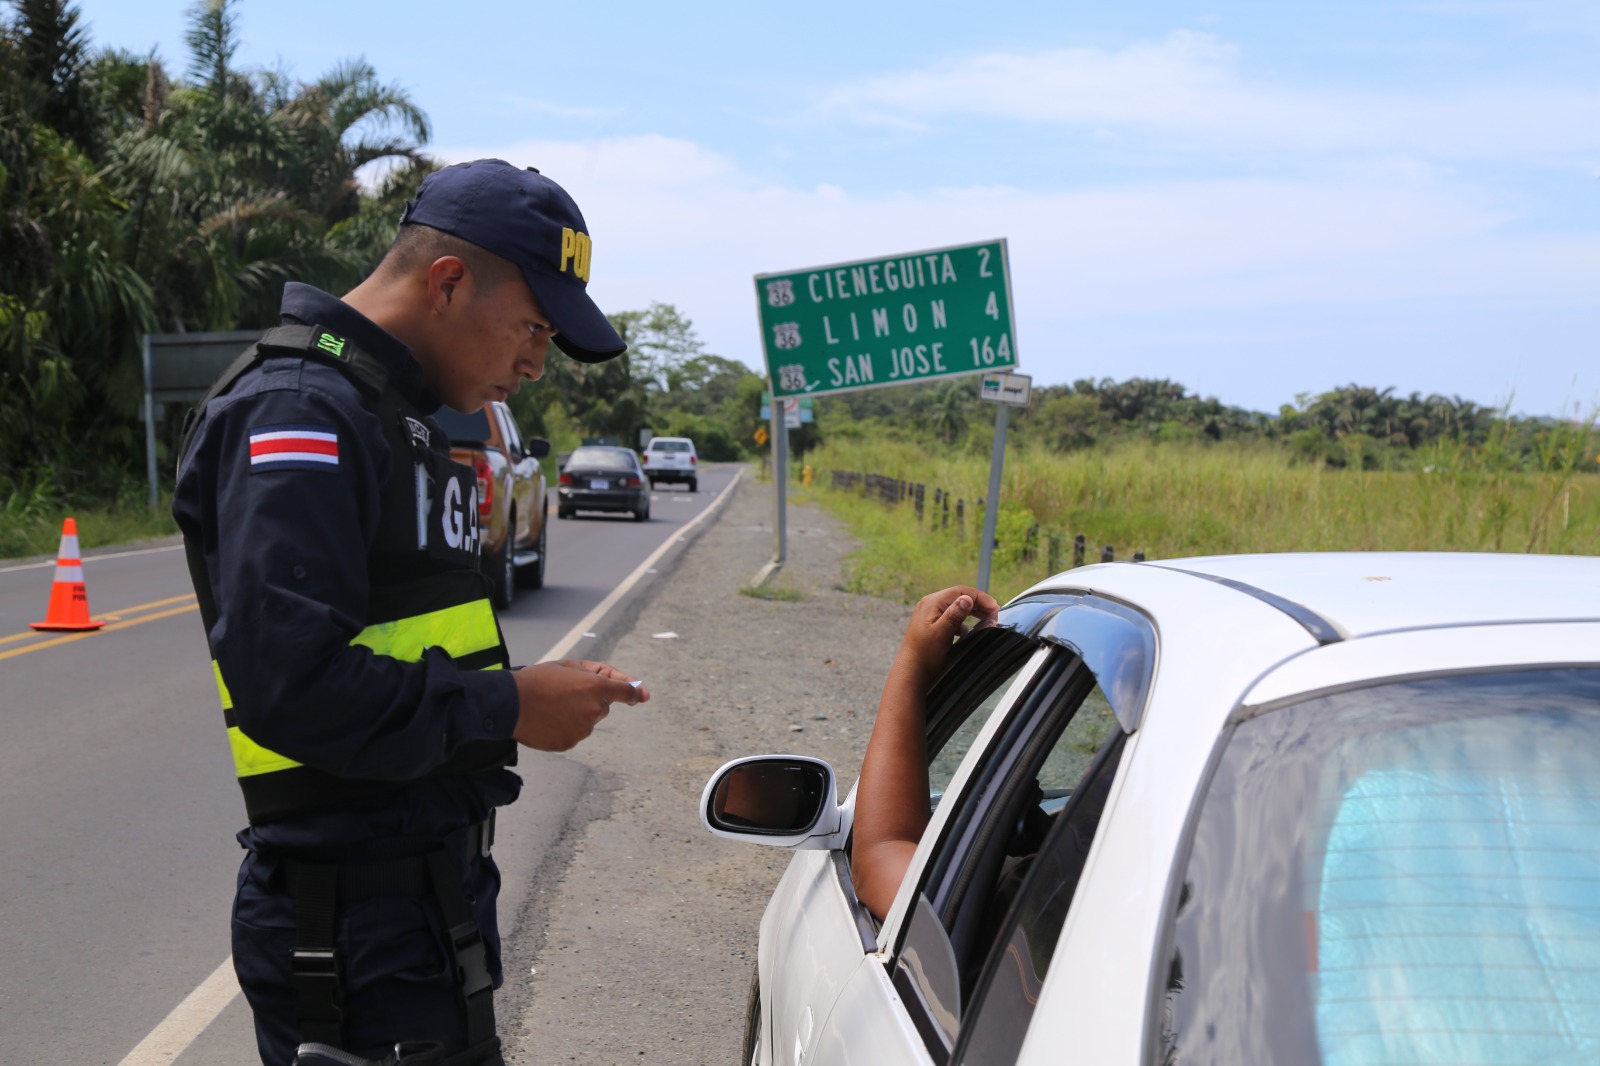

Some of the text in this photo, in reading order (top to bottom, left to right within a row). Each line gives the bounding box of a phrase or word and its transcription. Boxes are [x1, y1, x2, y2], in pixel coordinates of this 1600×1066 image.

[808, 253, 957, 303] CIENEGUITA
[977, 248, 993, 278] 2
[823, 299, 948, 345] LIMON
[985, 291, 999, 320] 4
[827, 353, 874, 387] SAN
[889, 342, 947, 378] JOSE
[969, 333, 1011, 366] 164
